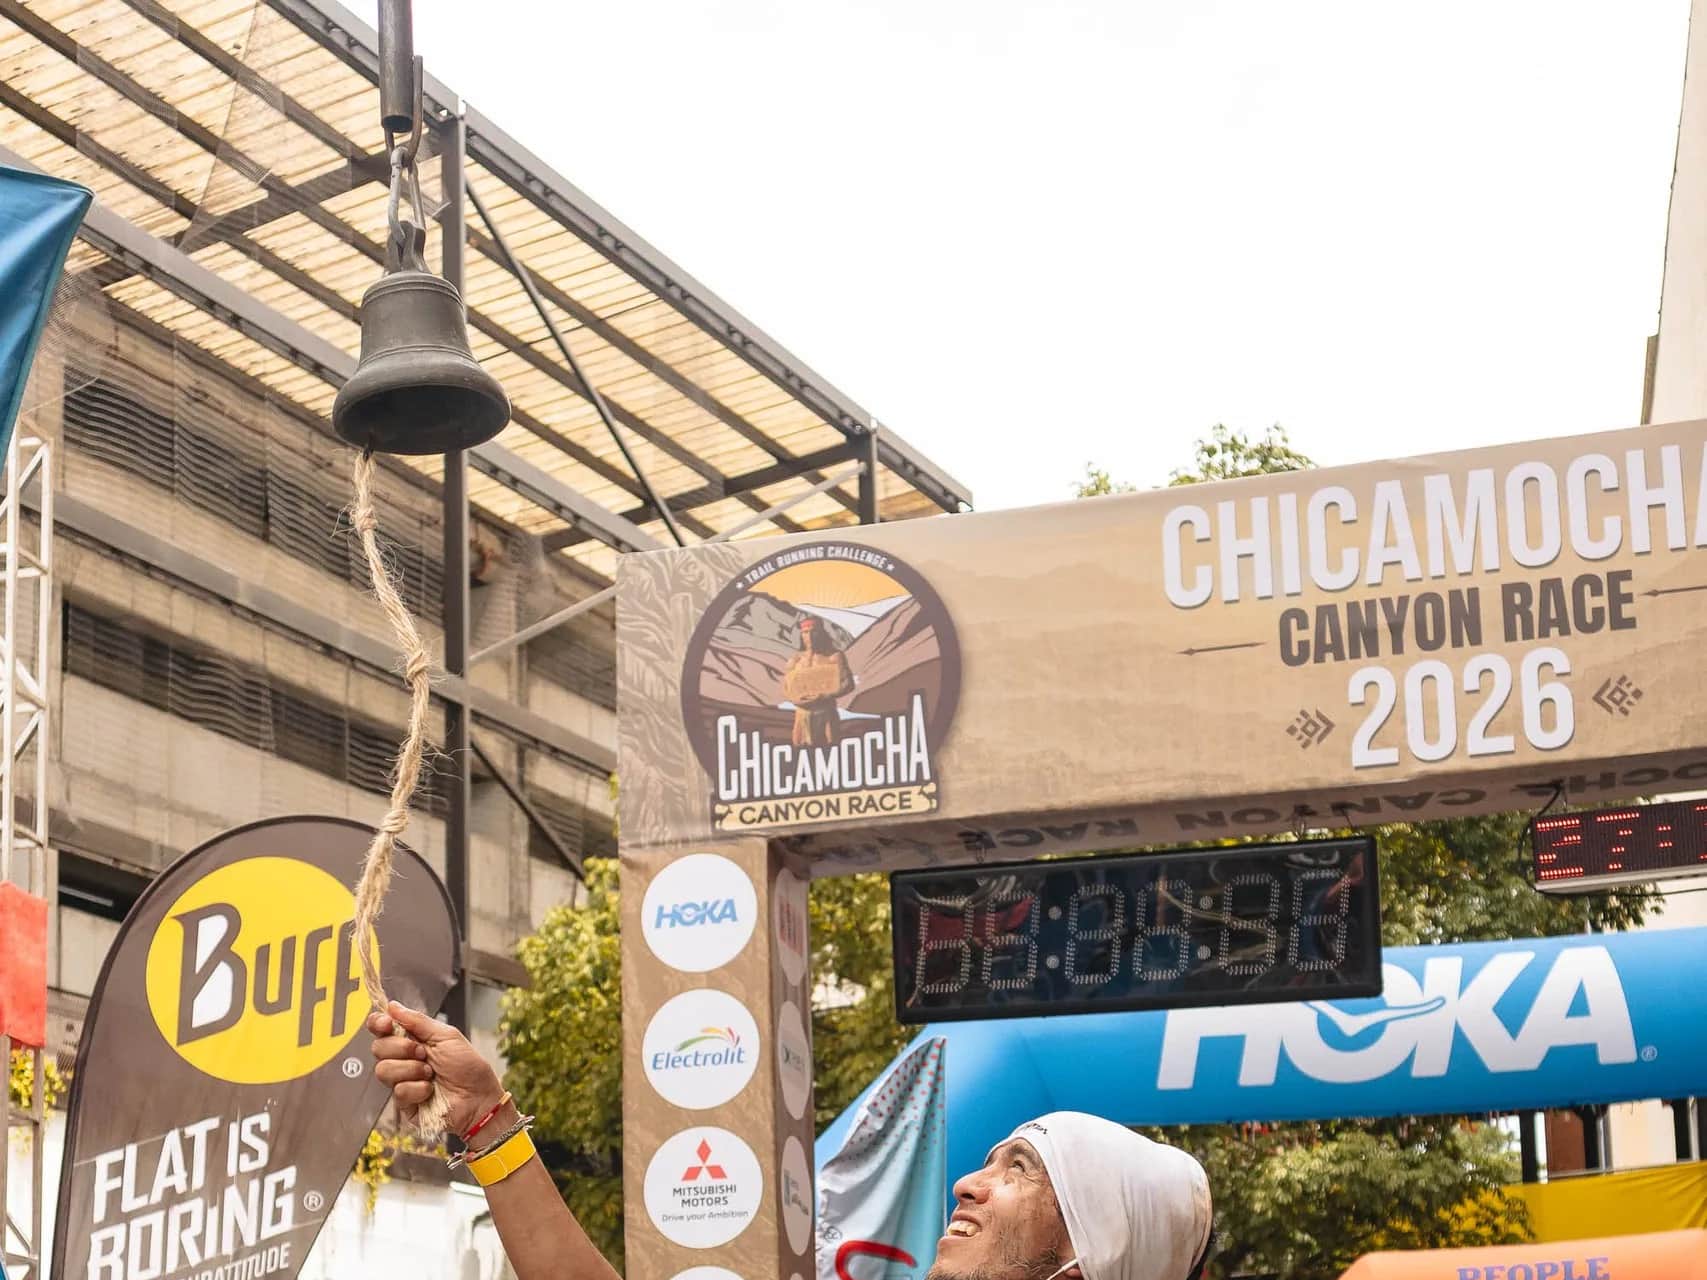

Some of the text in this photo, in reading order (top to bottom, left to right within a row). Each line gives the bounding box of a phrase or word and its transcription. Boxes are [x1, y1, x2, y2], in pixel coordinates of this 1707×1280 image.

[1162, 444, 1707, 609] CHICAMOCH
[745, 546, 887, 583] TRAIL RUNNING CHALLENGE
[1279, 570, 1638, 667] CANYON RACE
[1348, 647, 1576, 769] 2026
[717, 694, 931, 800] CHICAMOCHA
[738, 790, 912, 826] CANYON RACE
[655, 898, 738, 929] HOKA
[1157, 947, 1637, 1091] HOKA
[652, 1046, 747, 1072] Electrolit
[93, 1111, 271, 1225] FLAT IS
[673, 1184, 737, 1198] MITSUBISHI
[681, 1196, 729, 1208] MOTORS
